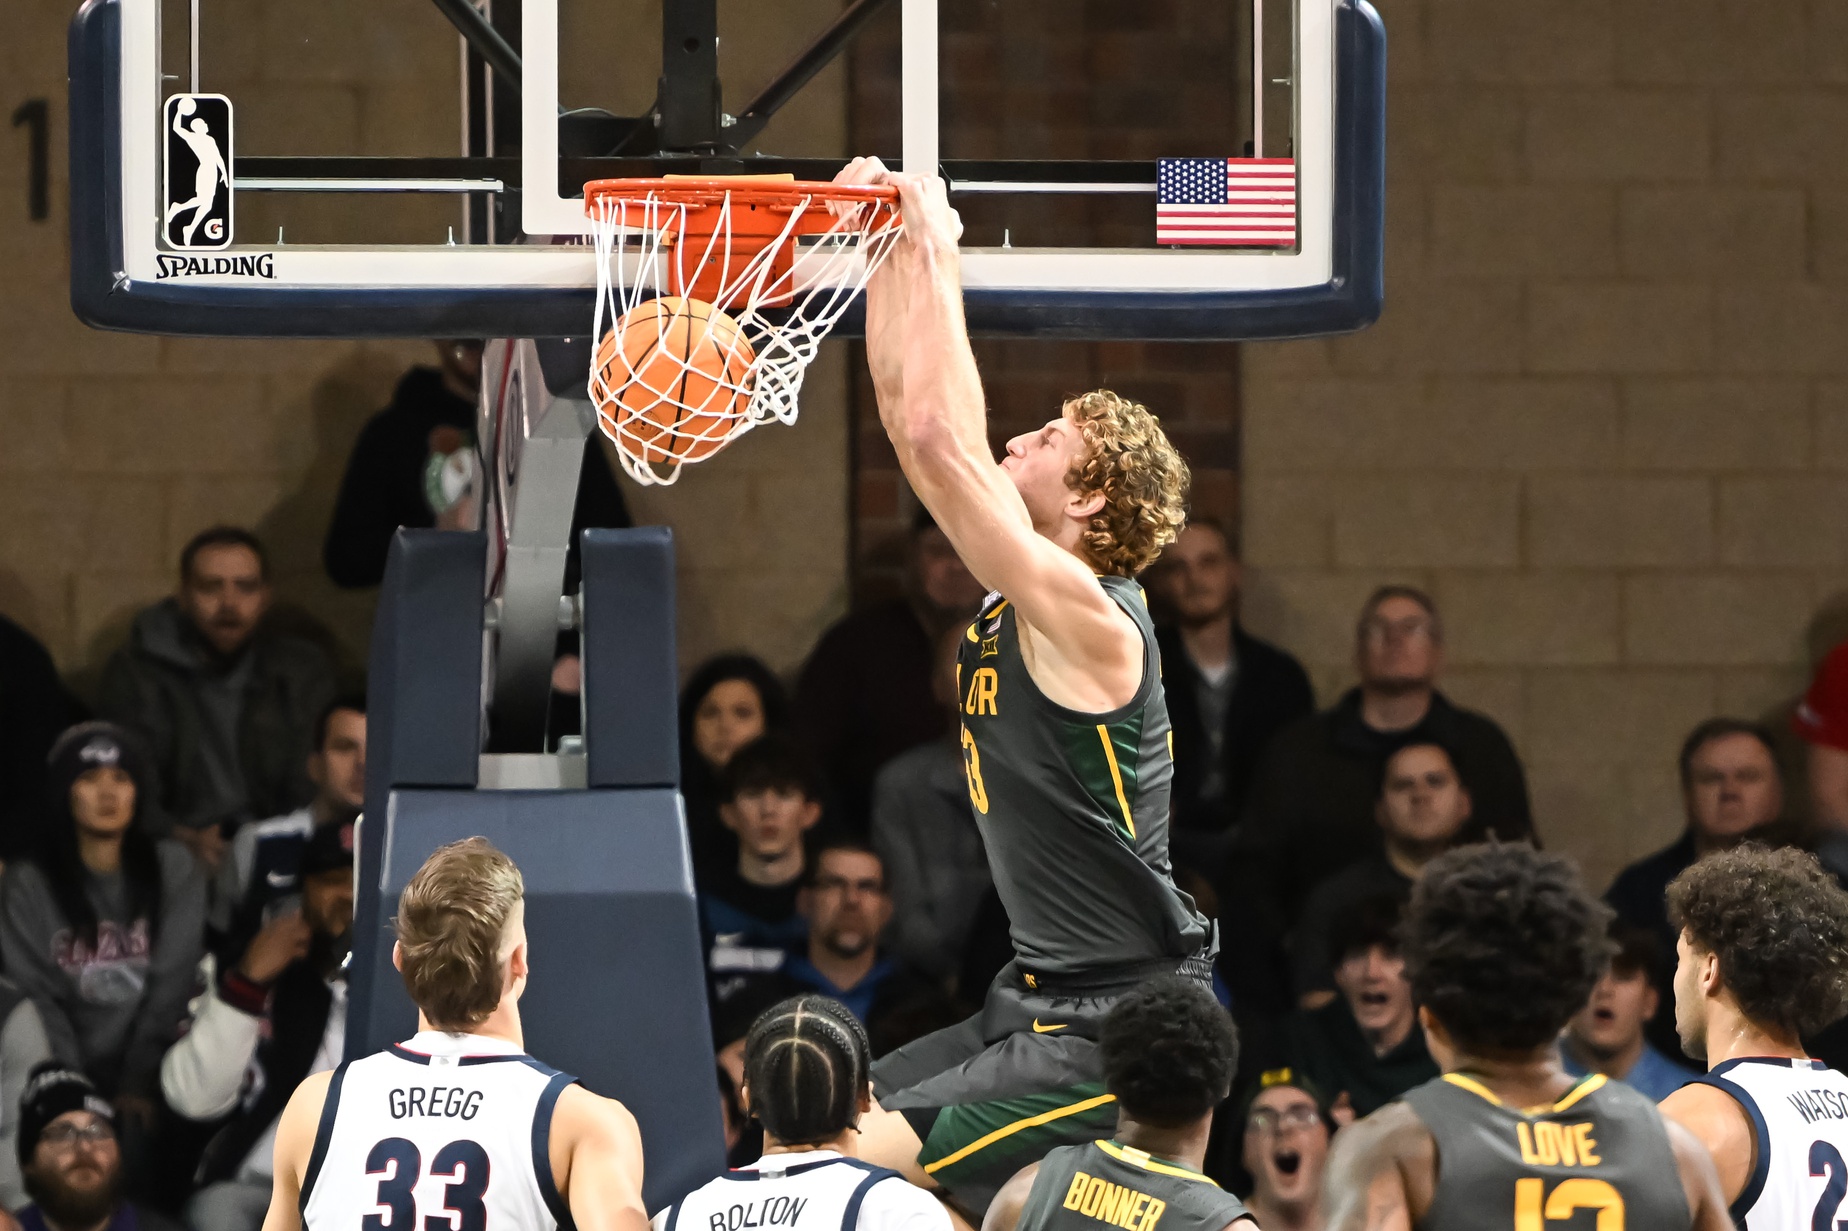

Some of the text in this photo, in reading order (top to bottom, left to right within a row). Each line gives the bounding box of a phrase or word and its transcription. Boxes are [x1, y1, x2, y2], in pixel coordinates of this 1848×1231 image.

[11, 98, 48, 221] 1
[204, 218, 223, 239] G
[156, 253, 273, 279] SPALDING
[956, 664, 998, 715] OR
[389, 1086, 484, 1121] GREGG
[1516, 1121, 1602, 1167] LOVE
[361, 1137, 491, 1231] 33
[1063, 1171, 1166, 1231] BONNER
[709, 1196, 808, 1231] BOLTON
